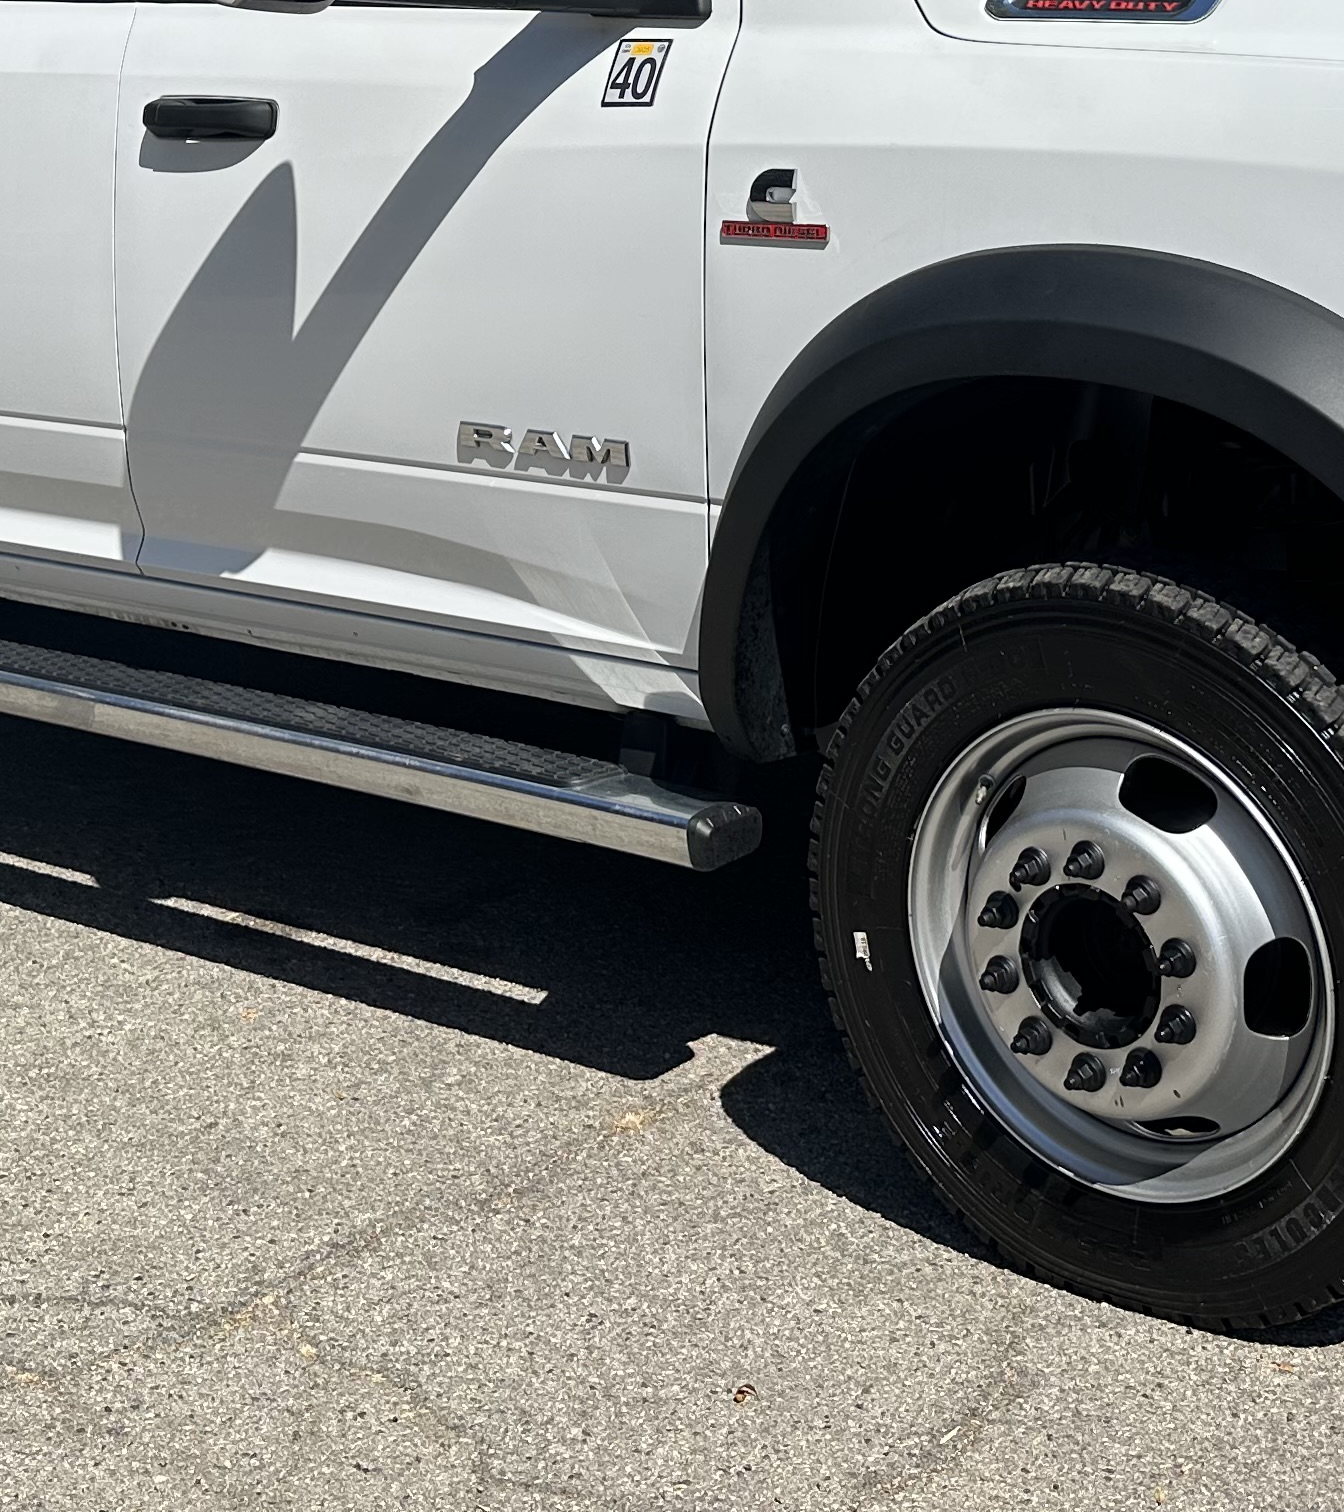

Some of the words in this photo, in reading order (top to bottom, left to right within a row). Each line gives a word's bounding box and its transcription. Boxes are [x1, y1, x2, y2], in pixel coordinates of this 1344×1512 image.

[1108, 0, 1179, 12] DUTY
[609, 56, 657, 100] 40
[456, 420, 631, 468] RAM
[884, 673, 956, 755] GUARD
